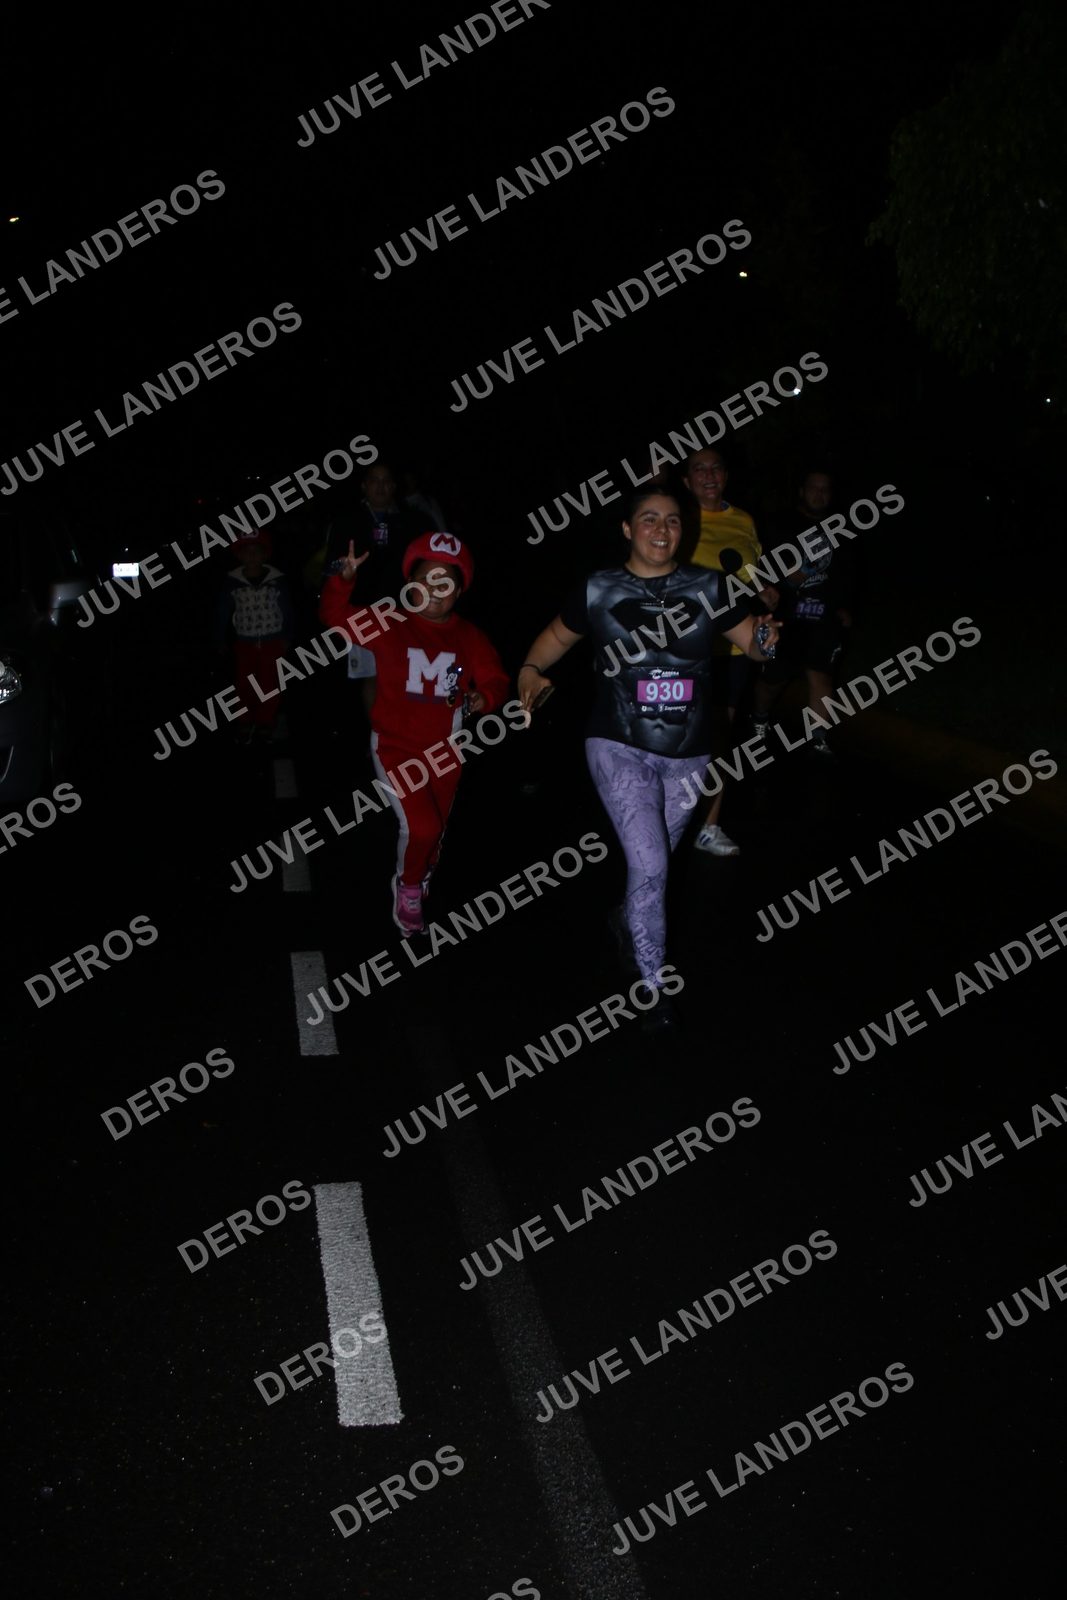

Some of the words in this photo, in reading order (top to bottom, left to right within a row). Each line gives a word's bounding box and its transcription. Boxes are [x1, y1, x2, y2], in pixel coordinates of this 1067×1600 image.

[433, 534, 457, 552] M
[404, 646, 457, 698] M
[646, 681, 684, 702] 930
